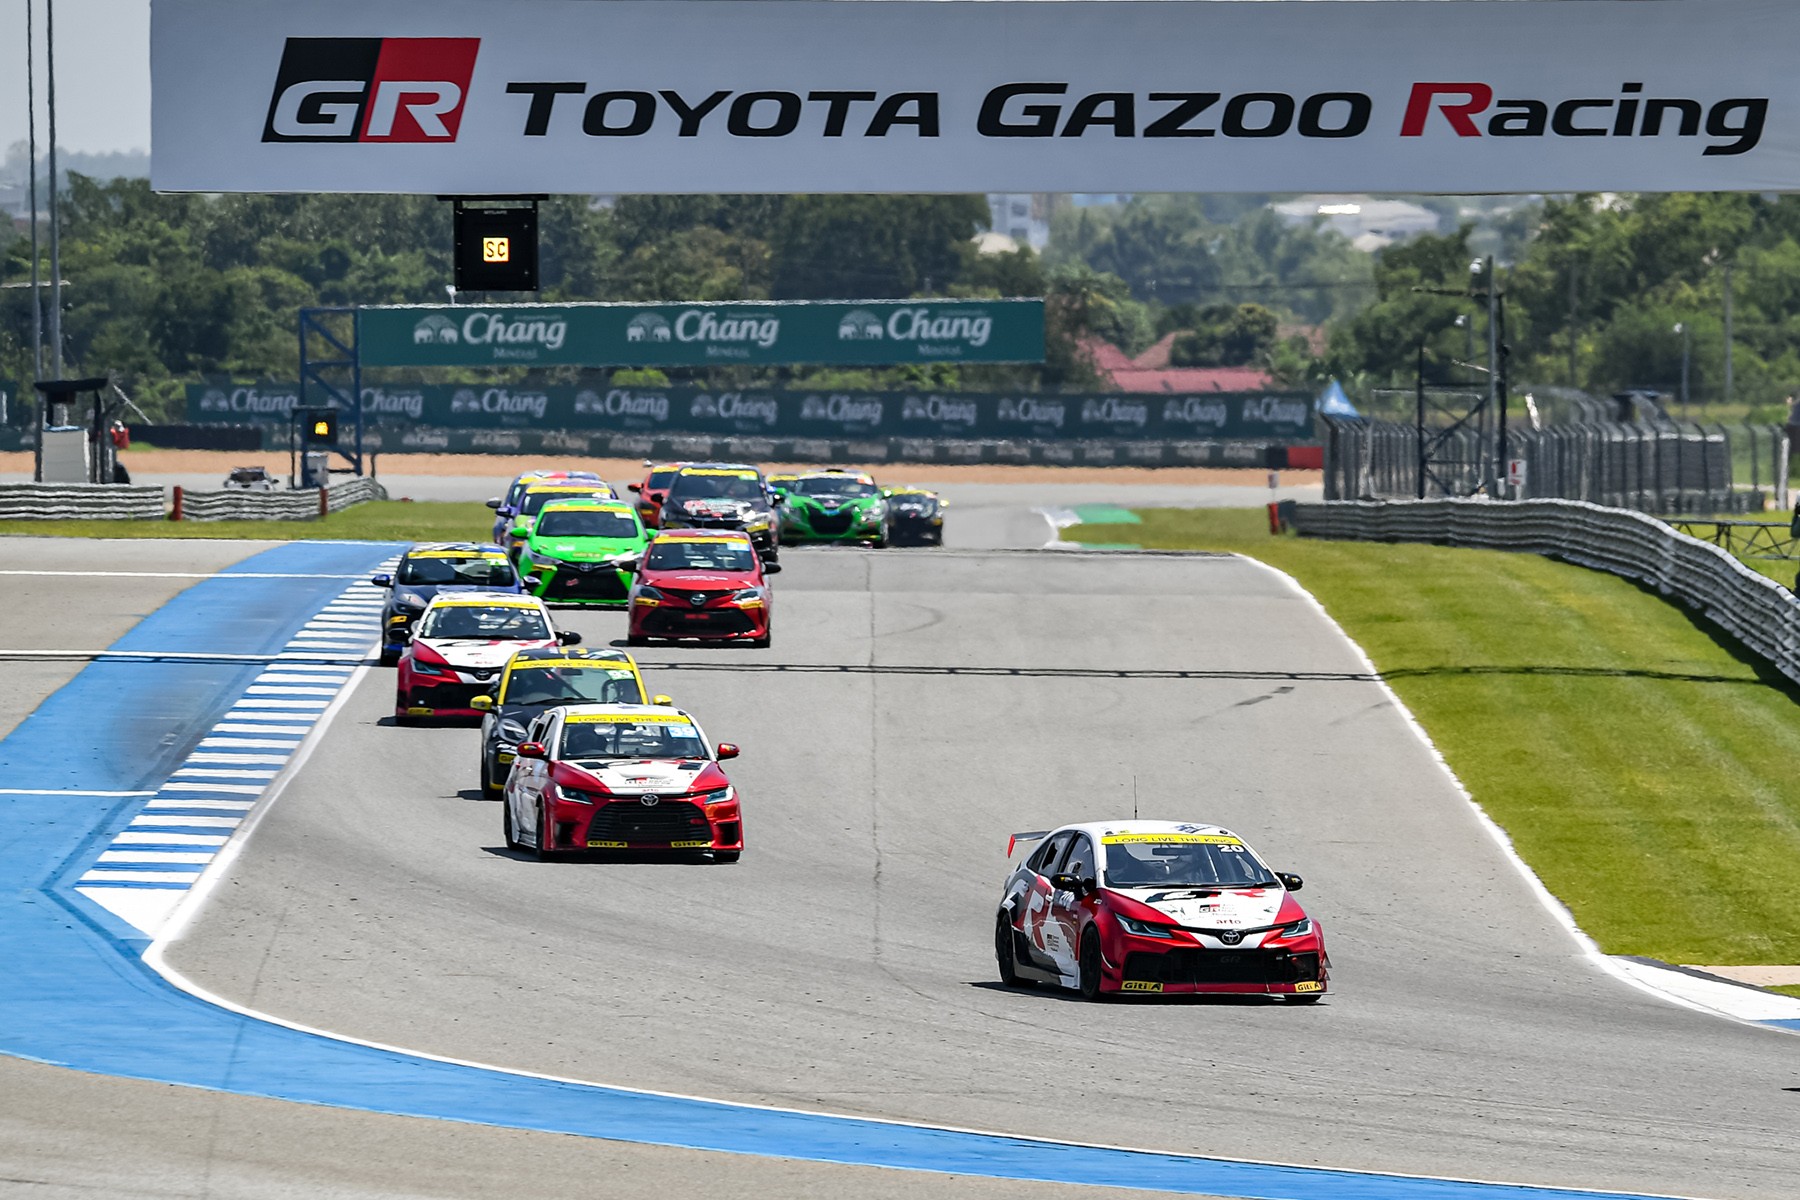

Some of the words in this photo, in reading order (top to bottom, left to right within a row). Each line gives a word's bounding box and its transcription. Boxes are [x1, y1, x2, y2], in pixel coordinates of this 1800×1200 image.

[272, 80, 461, 137] GR
[505, 81, 941, 138] TOYOTA
[976, 82, 1372, 138] GAZOO
[1399, 82, 1769, 156] Racing
[485, 240, 506, 258] SC
[462, 312, 567, 349] Chang
[674, 309, 780, 347] Chang
[887, 308, 993, 346] Chang
[361, 388, 424, 419] Chang
[481, 388, 548, 418] Chang
[605, 389, 670, 421] Chang
[718, 392, 778, 425] Chang
[827, 394, 883, 425] Chang
[670, 726, 696, 737] 39
[1217, 844, 1245, 853] 20
[1123, 982, 1147, 990] Giti
